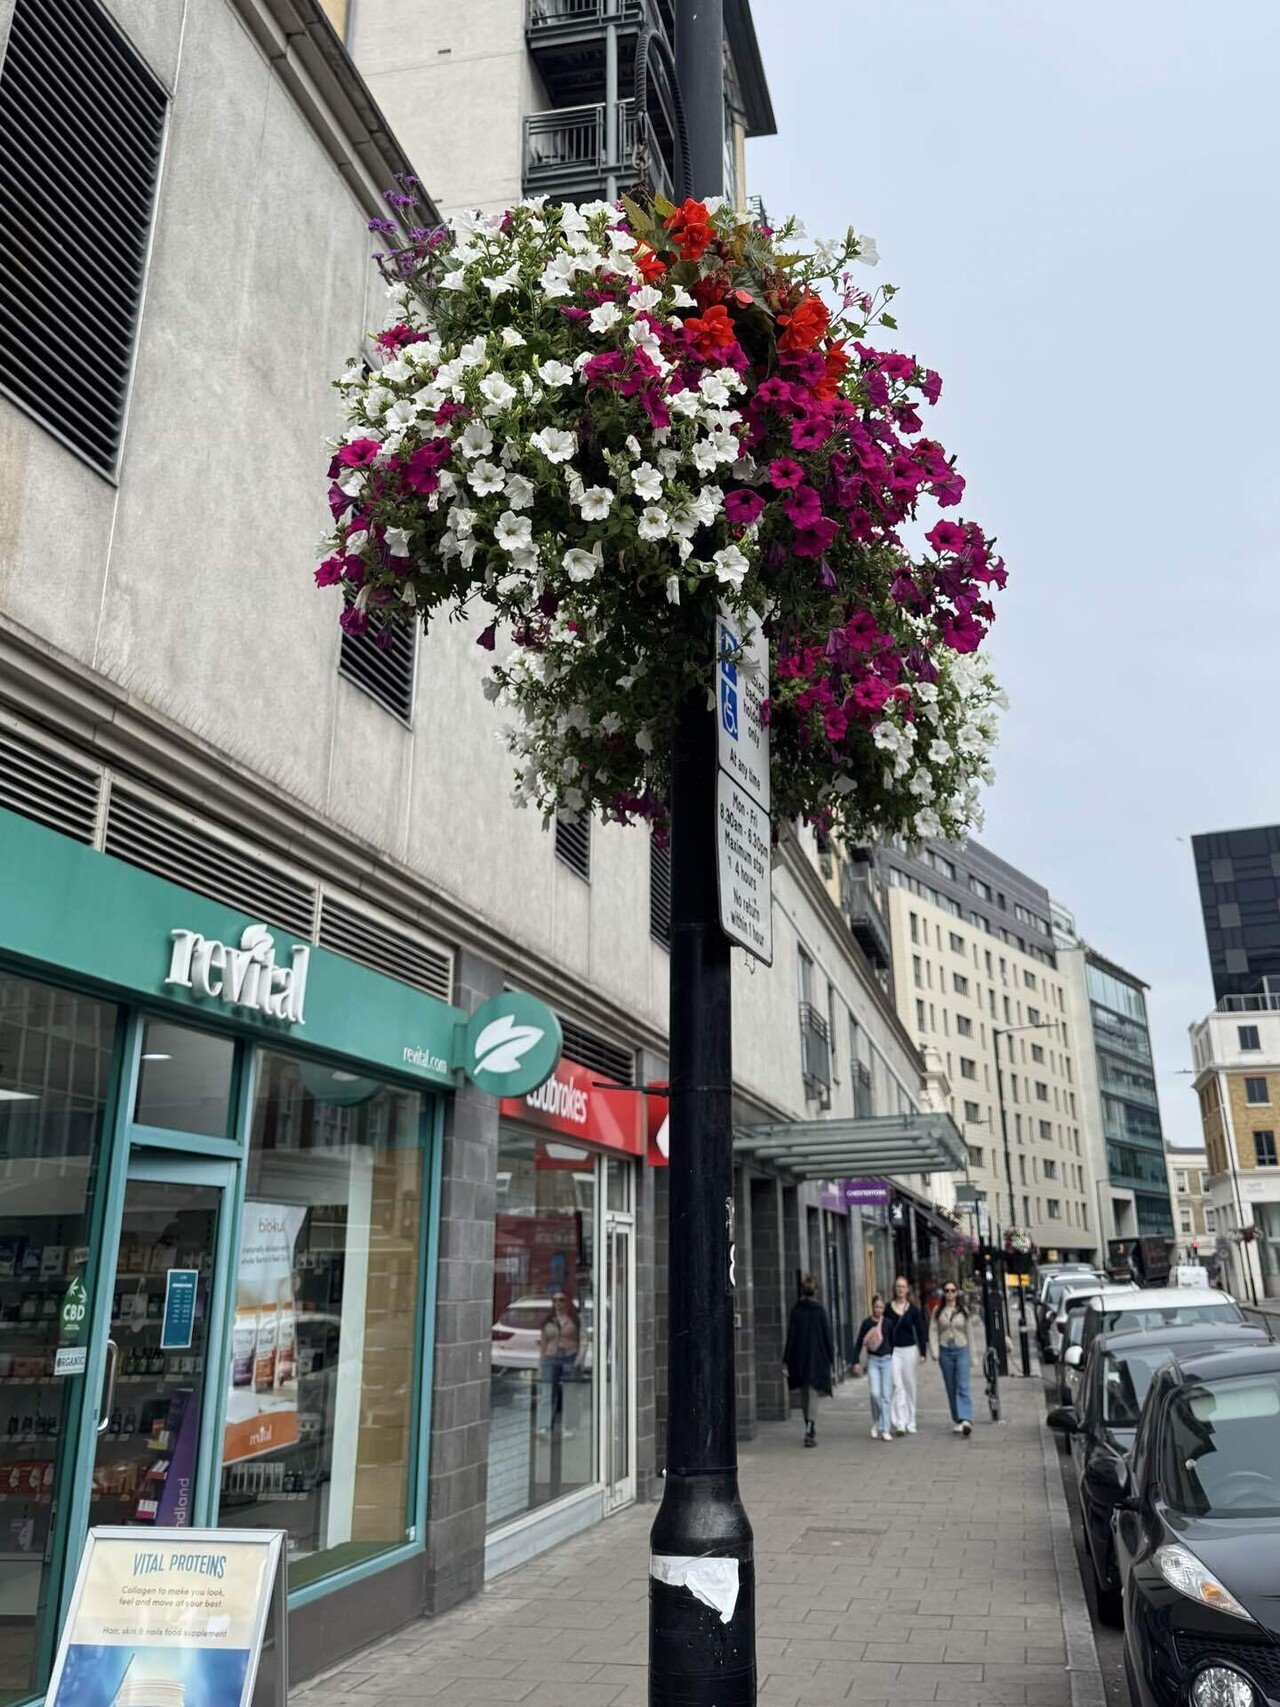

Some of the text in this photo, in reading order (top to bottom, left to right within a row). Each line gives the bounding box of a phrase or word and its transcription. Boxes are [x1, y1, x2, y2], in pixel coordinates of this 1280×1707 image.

[748, 726, 760, 749] only
[730, 747, 761, 791] At any time
[720, 803, 743, 832] 8.30am
[733, 791, 746, 817] Mon
[750, 809, 758, 829] Fri
[725, 829, 764, 880] Maximum stay
[735, 861, 757, 892] 4 hours
[733, 887, 760, 923] No return
[730, 910, 748, 935] within
[753, 923, 764, 947] hour
[165, 924, 310, 1025] revital
[403, 1045, 448, 1075] revital.com
[63, 1303, 85, 1321] CBD
[133, 1553, 227, 1579] VITAL PROTEINS
[119, 1598, 134, 1606] feel
[135, 1598, 151, 1606] and
[186, 1600, 203, 1609] your
[122, 1585, 157, 1597] Collagen
[158, 1587, 166, 1595] to
[168, 1587, 189, 1596] make
[191, 1589, 205, 1599] you
[122, 1627, 137, 1635] skin
[145, 1628, 163, 1636] nails
[164, 1628, 182, 1636] food
[184, 1628, 228, 1639] supplement
